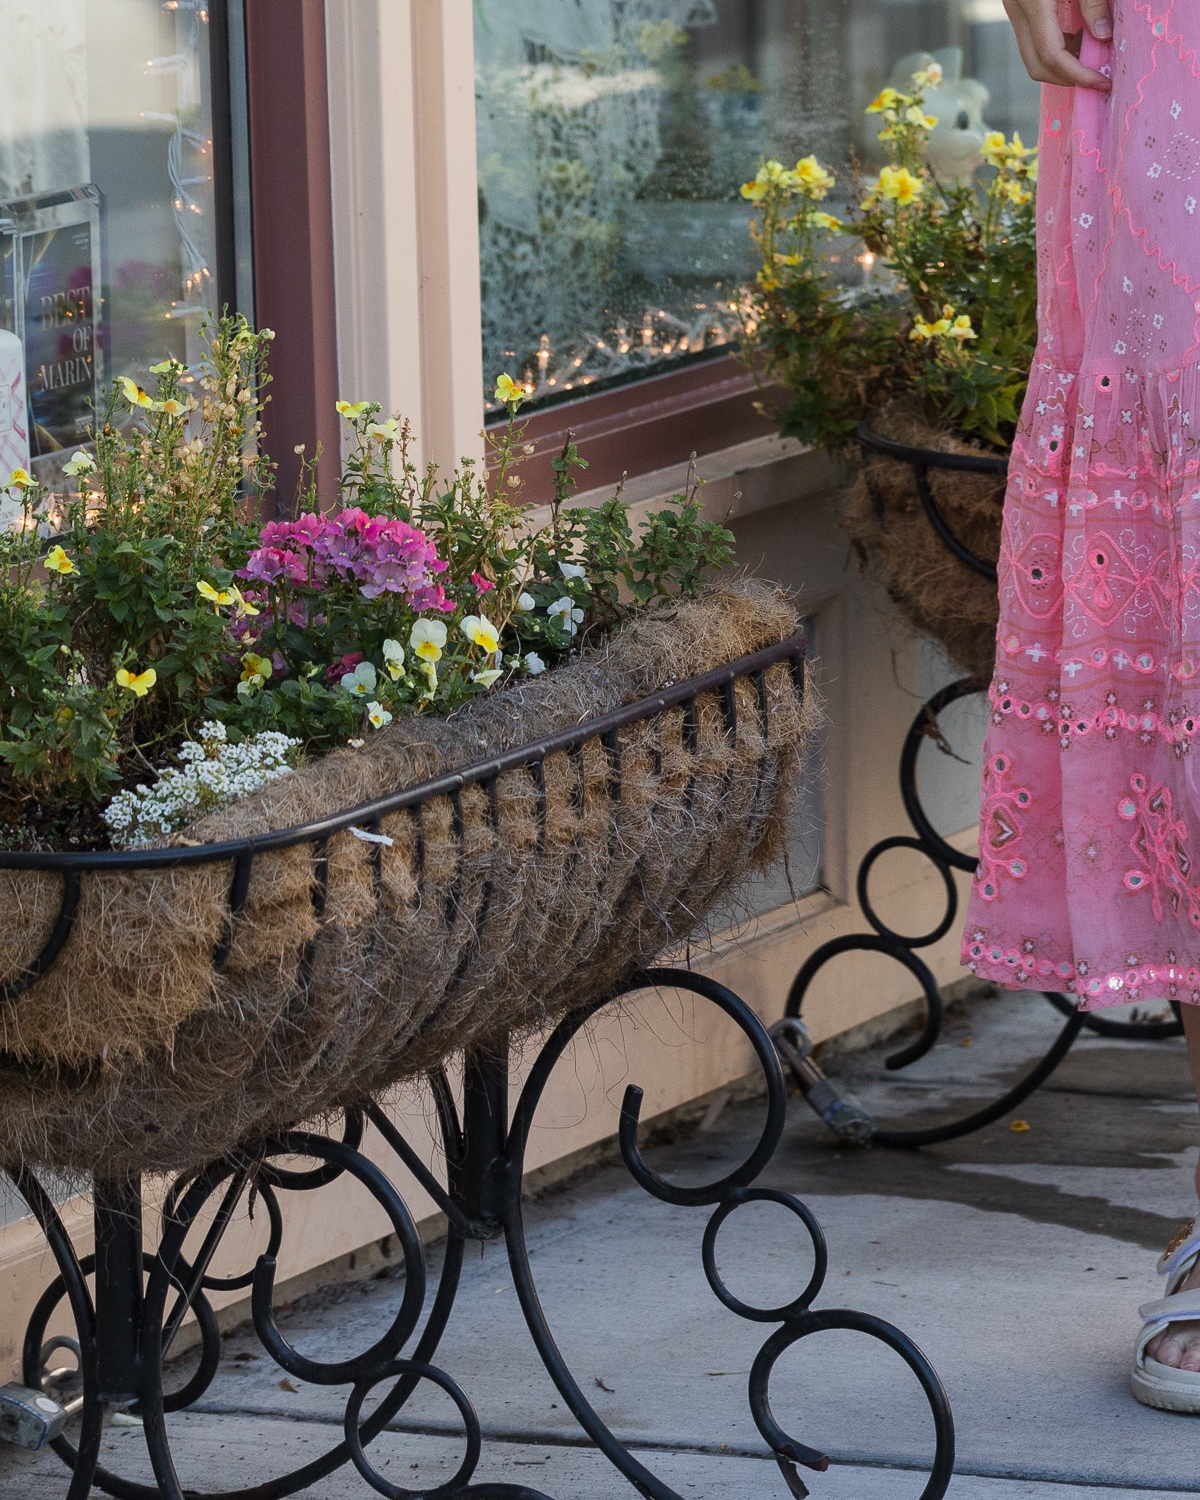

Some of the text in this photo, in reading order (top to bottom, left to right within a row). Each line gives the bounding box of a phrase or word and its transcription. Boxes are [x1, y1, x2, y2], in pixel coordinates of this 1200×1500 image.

[40, 286, 91, 332] BEST
[72, 325, 92, 354] OF
[40, 356, 93, 392] MARIN
